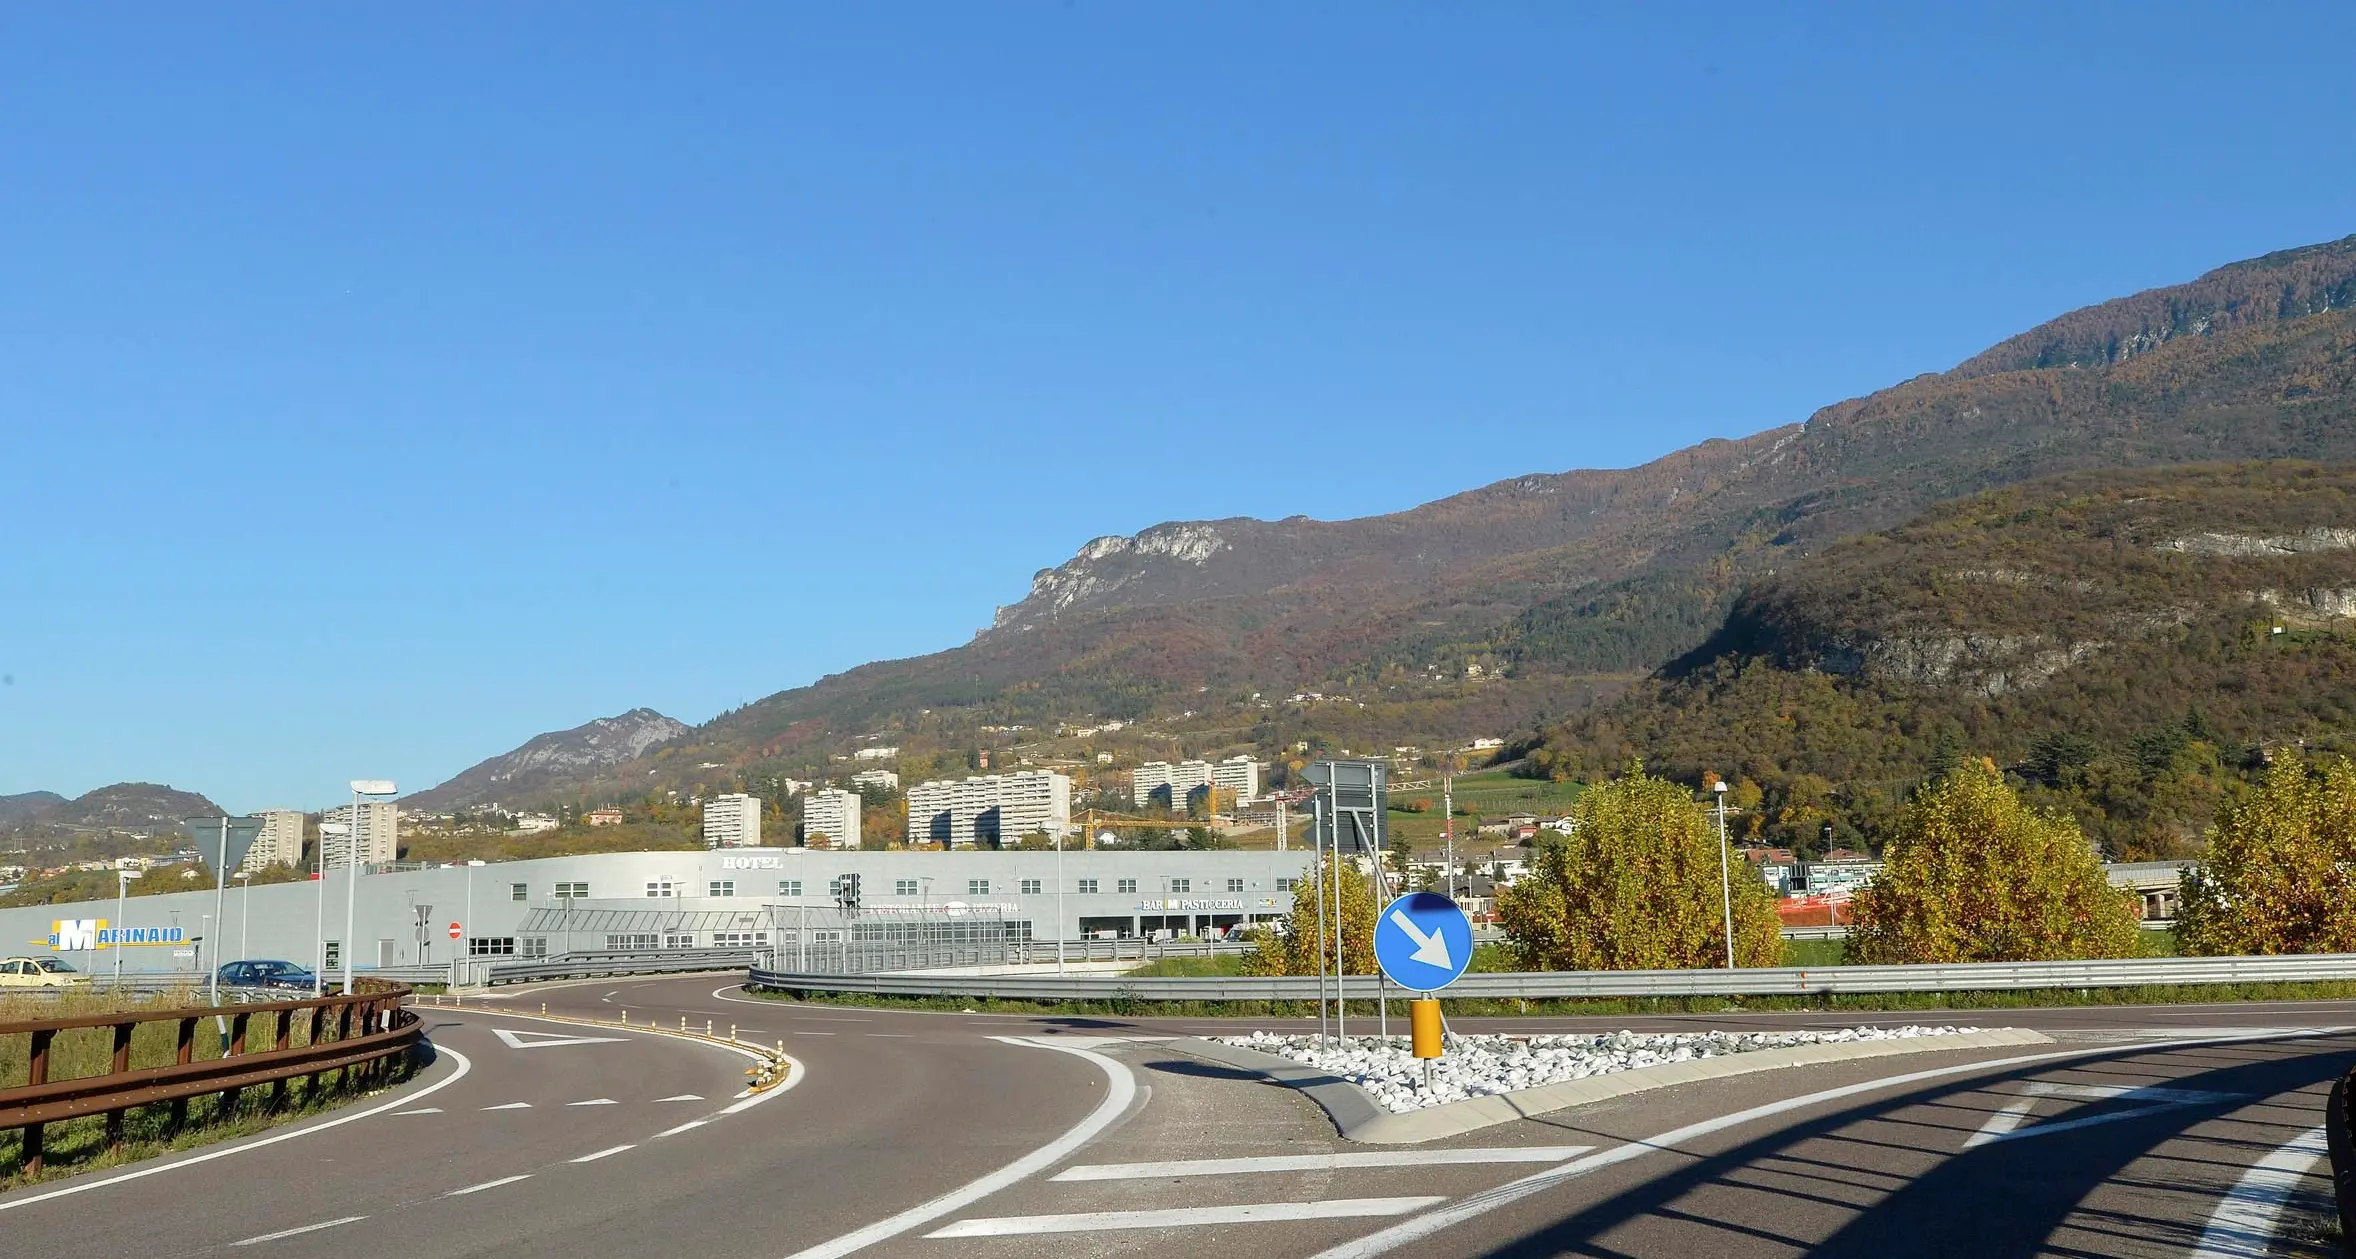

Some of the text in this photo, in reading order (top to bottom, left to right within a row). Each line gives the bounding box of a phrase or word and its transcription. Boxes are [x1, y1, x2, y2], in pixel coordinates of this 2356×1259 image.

[722, 856, 784, 869] HOTEL
[1142, 899, 1163, 911] BAR
[1180, 899, 1244, 910] PASTICCERIA
